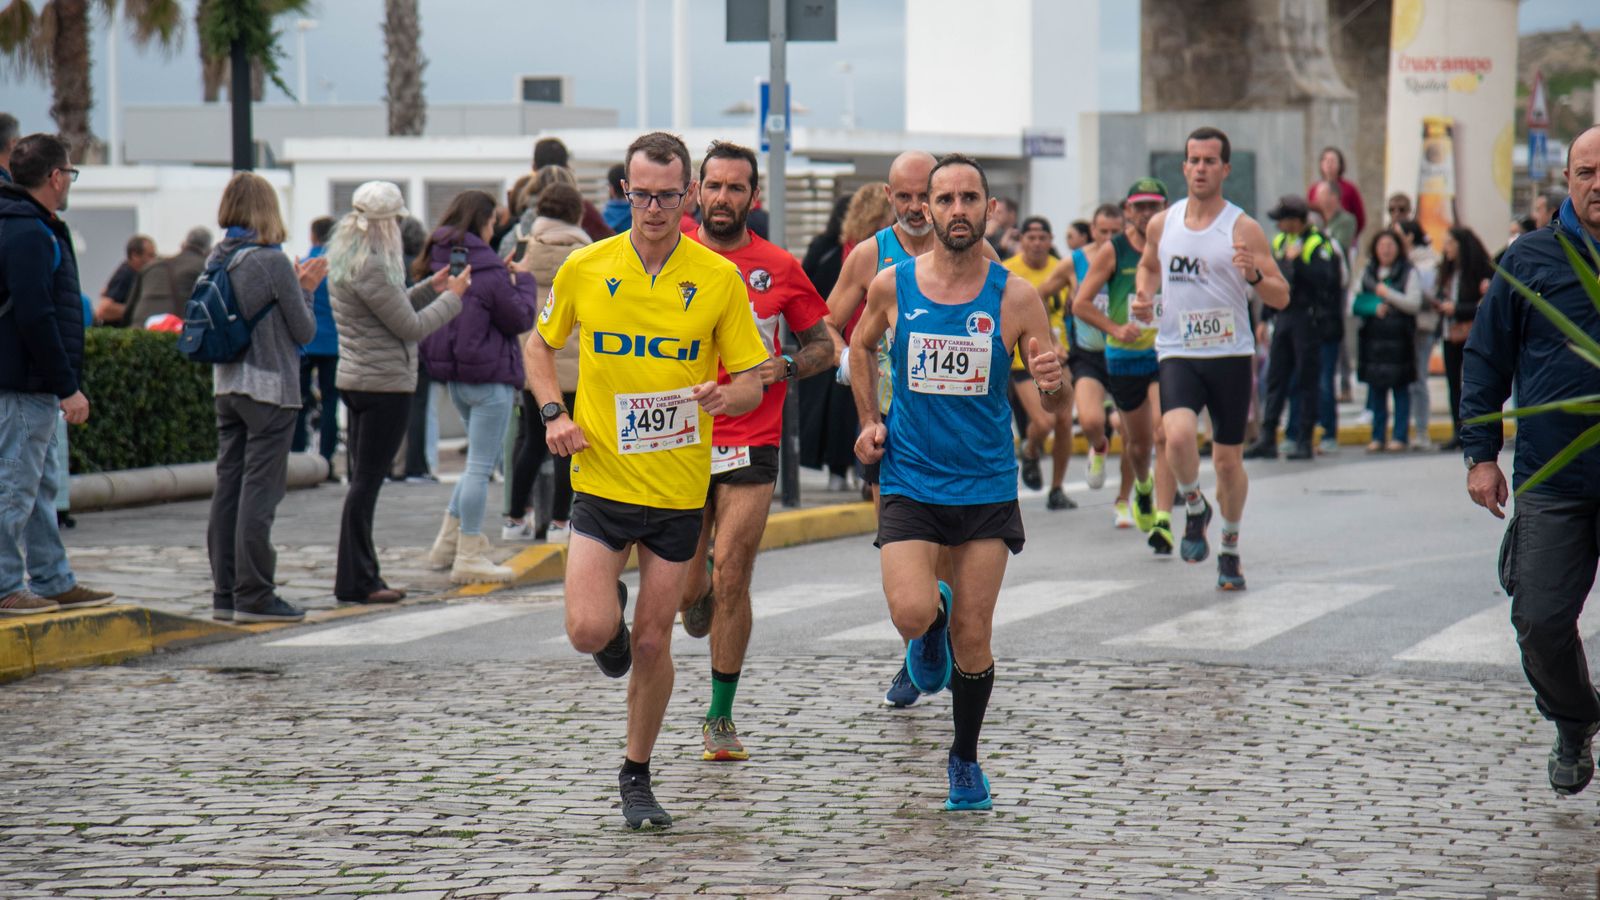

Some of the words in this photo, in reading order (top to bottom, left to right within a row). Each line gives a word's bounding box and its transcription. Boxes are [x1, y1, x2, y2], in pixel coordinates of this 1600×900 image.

[1194, 318, 1220, 335] 450
[594, 331, 700, 361] DIGI
[922, 338, 948, 350] XIV
[929, 350, 969, 375] 149
[629, 397, 656, 409] XIV
[655, 394, 681, 402] CARRERA
[637, 406, 678, 432] 497
